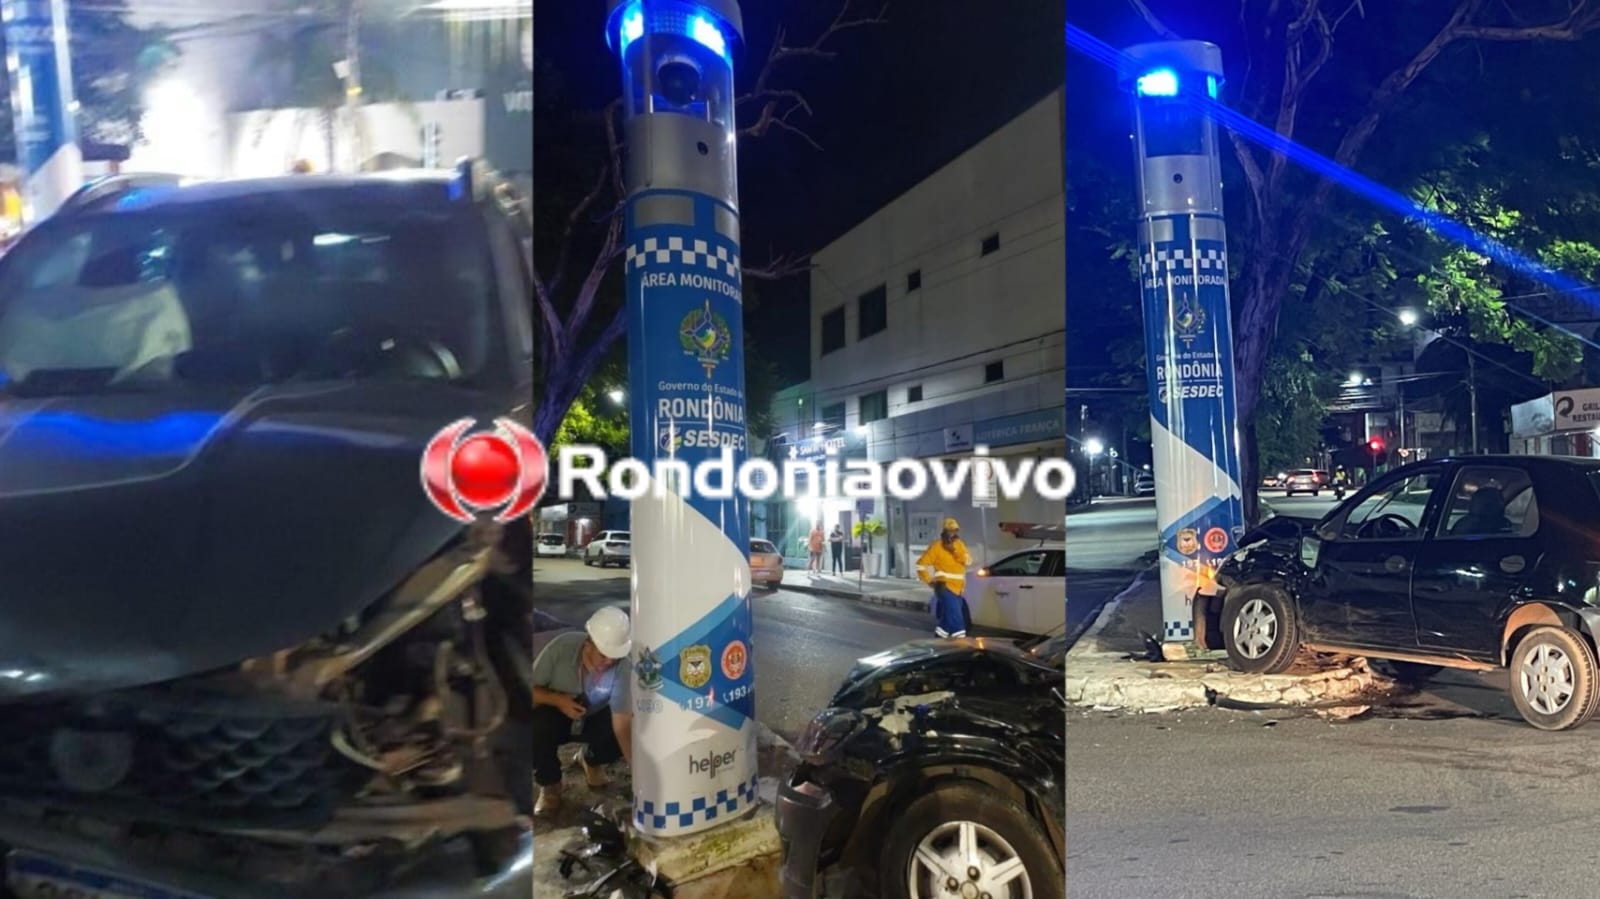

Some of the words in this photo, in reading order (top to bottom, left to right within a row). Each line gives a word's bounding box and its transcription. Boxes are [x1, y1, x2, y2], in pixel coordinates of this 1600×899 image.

[642, 271, 677, 288] ÁREA
[1157, 360, 1223, 380] RONDÔNIA
[658, 381, 699, 391] Governo
[701, 382, 712, 392] do
[1173, 385, 1224, 399] SESDEC
[659, 396, 743, 424] RONDÔNIA
[684, 429, 744, 451] SESDEC
[729, 685, 746, 702] 193
[689, 749, 736, 779] helper
